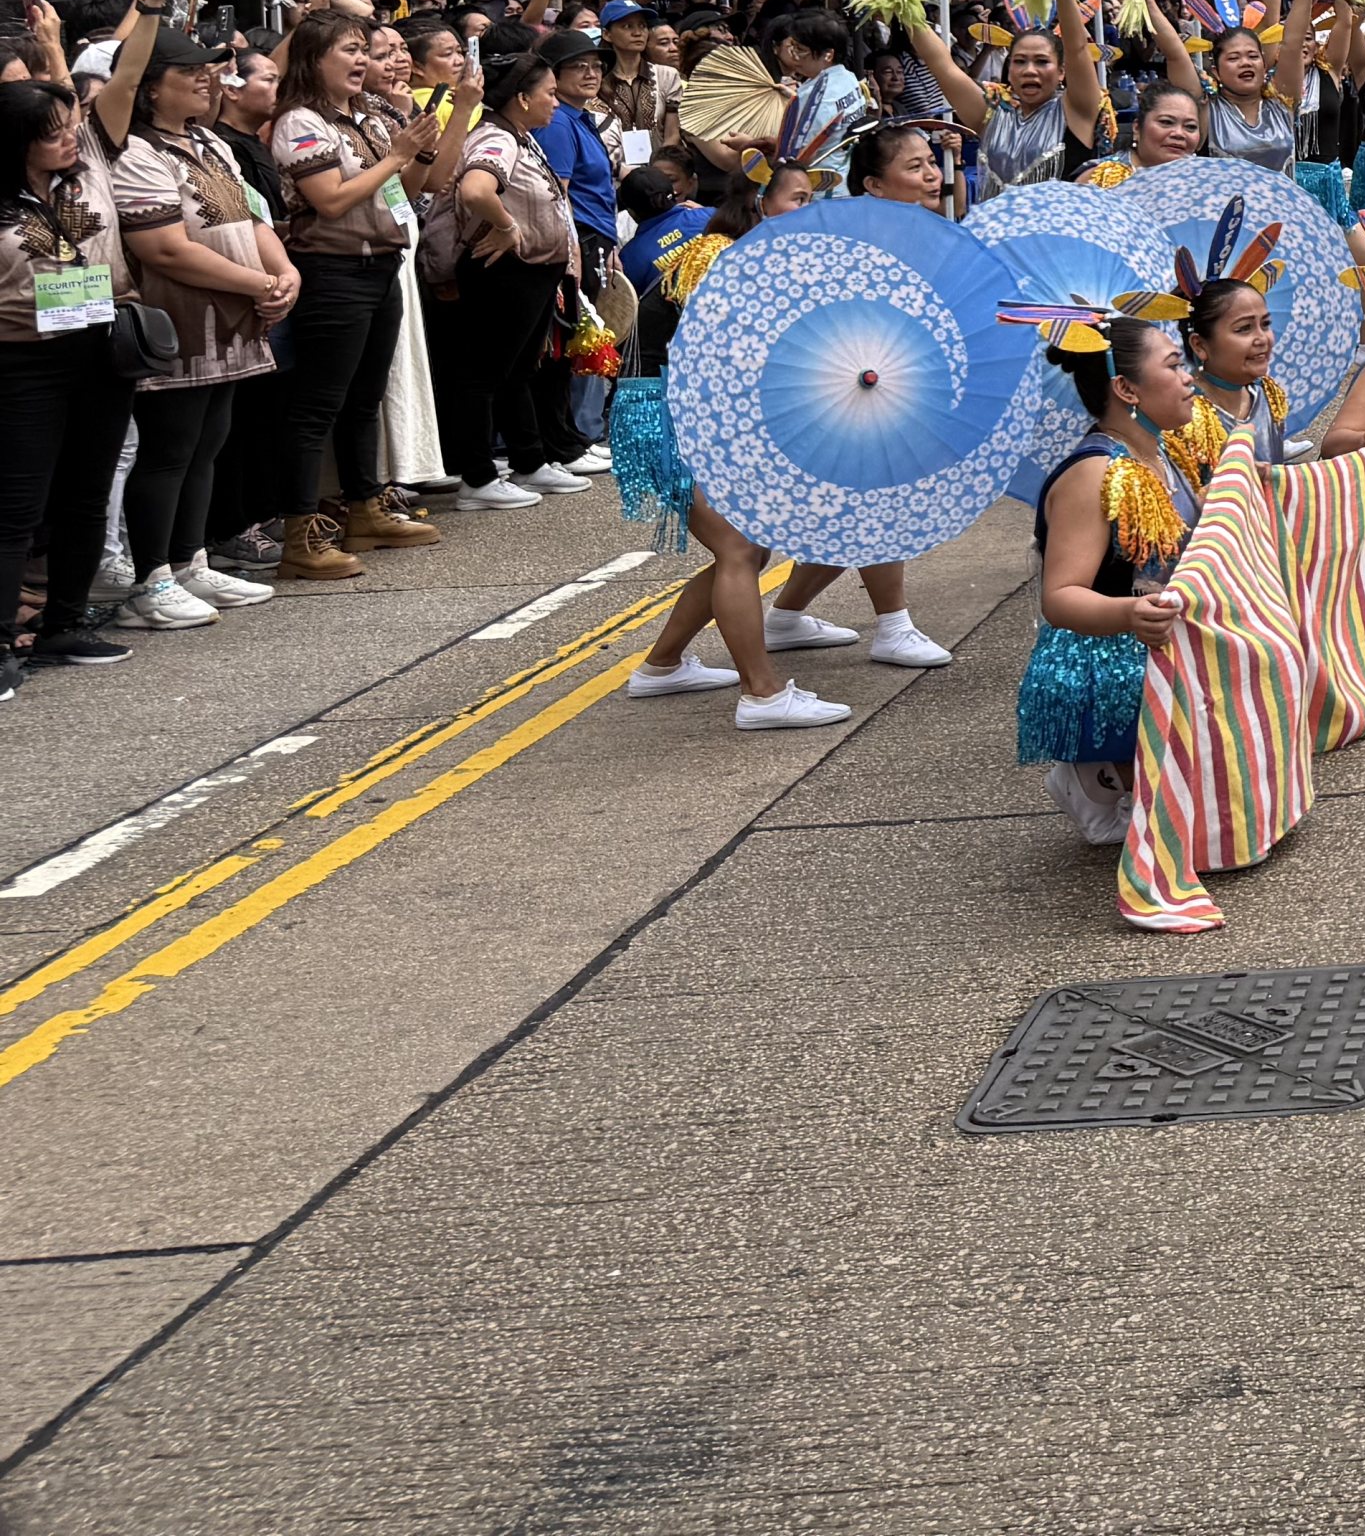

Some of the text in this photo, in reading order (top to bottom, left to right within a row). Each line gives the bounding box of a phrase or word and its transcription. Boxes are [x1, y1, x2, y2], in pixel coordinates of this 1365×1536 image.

[657, 229, 683, 248] 2026
[1213, 199, 1242, 275] LUFOH
[37, 280, 81, 292] SECURITY
